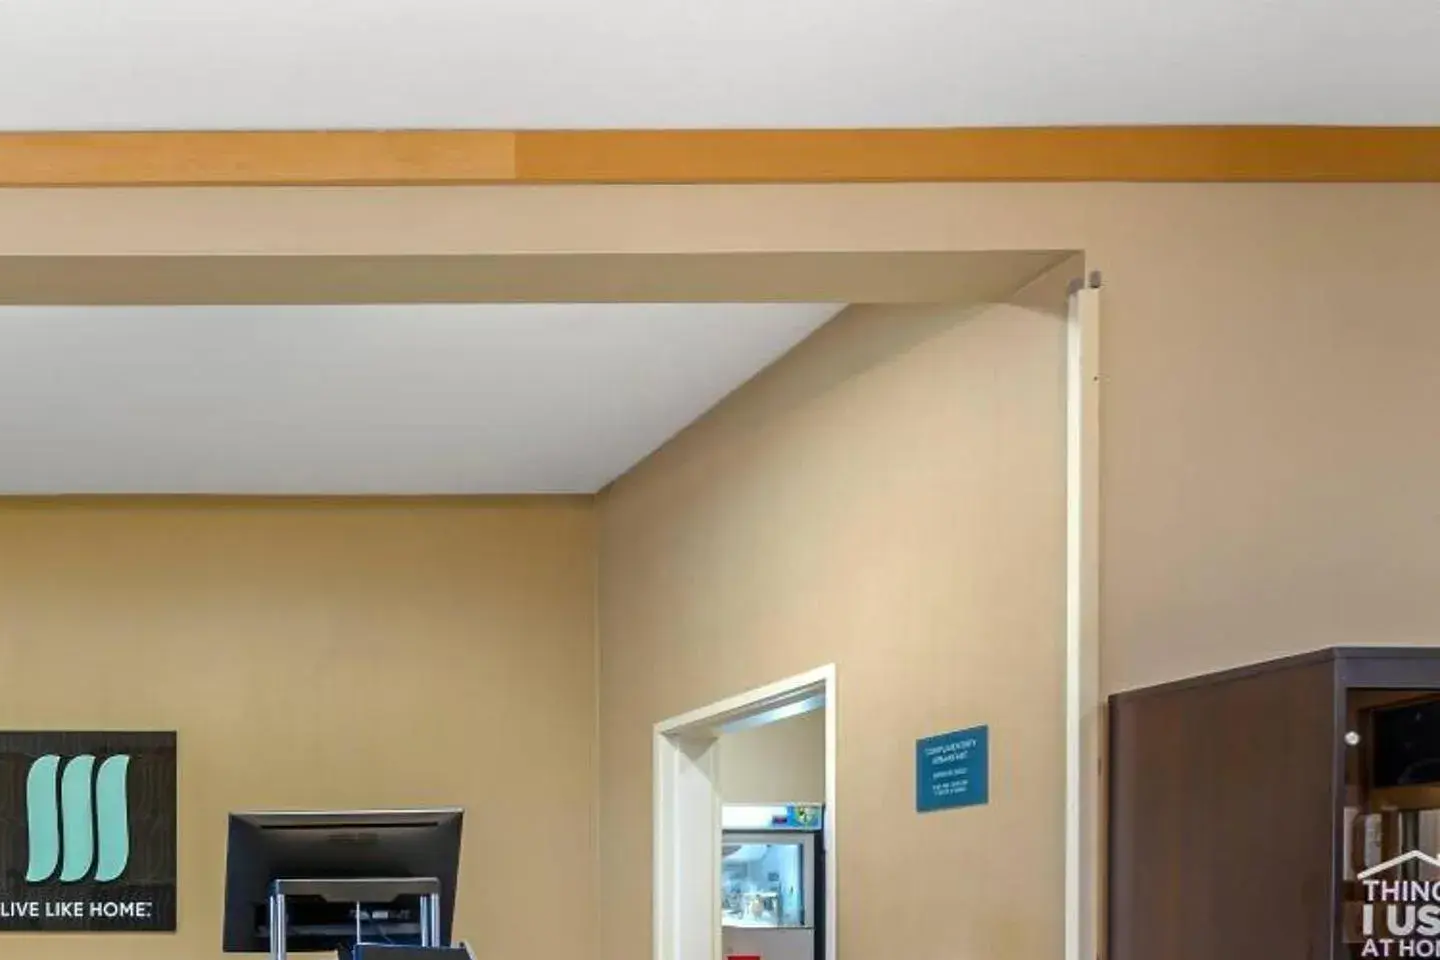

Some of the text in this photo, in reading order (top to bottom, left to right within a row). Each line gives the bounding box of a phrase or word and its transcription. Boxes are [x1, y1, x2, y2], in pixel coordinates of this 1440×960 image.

[0, 901, 40, 917] LIVE
[45, 901, 84, 917] LIKE
[1362, 903, 1374, 937] I
[1361, 938, 1440, 958] AT HO
